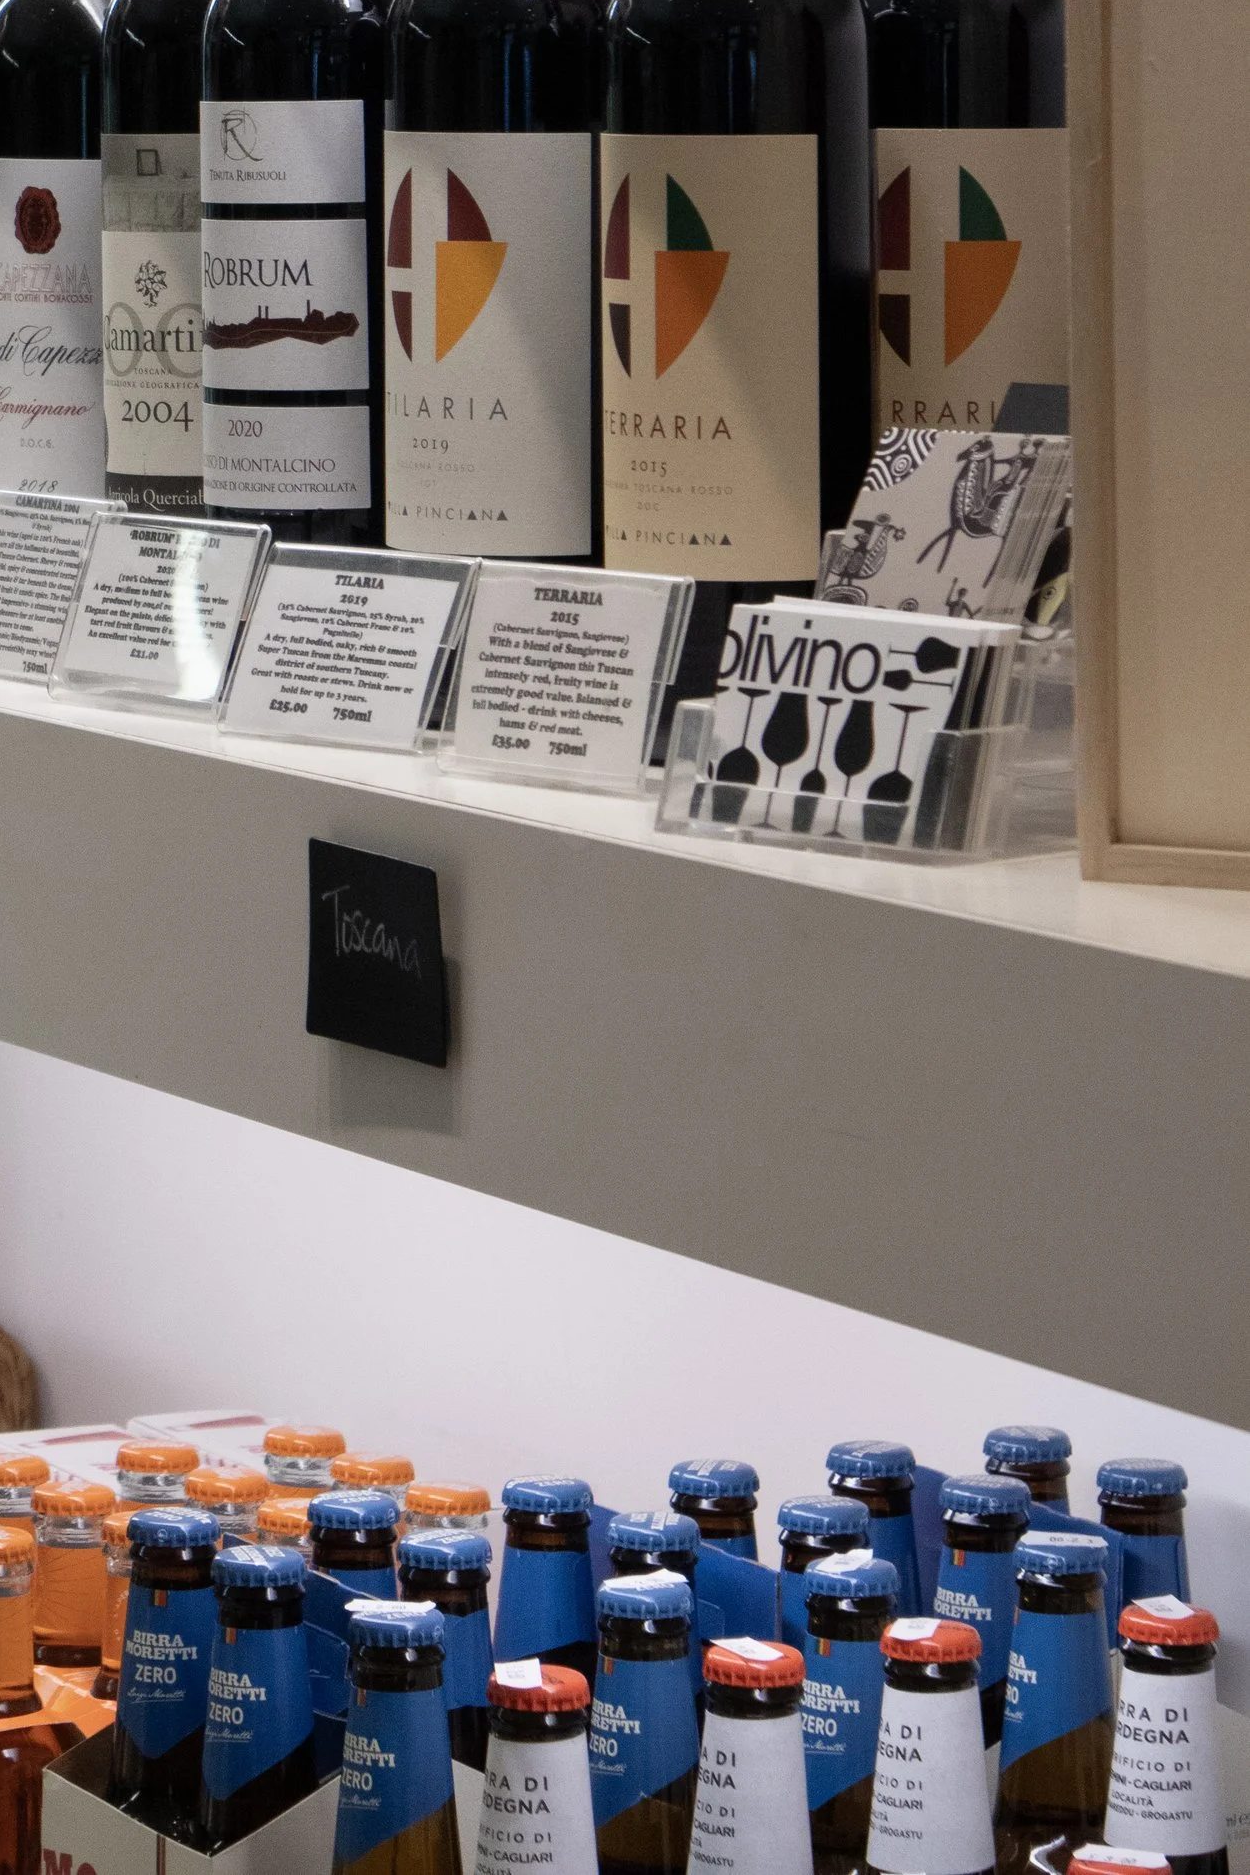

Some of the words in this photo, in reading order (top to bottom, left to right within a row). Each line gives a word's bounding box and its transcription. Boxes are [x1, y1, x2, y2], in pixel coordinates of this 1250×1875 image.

[204, 251, 314, 289] ROBRUM
[121, 400, 194, 433] 2004
[228, 420, 263, 437] 2020
[413, 438, 449, 455] 2019
[230, 458, 336, 473] MONTALCINO
[630, 460, 667, 478] 2015
[277, 482, 358, 493] CONTROLLATA
[335, 575, 385, 590] TILARIA
[534, 587, 603, 606] TERRARIA
[550, 611, 580, 626] 2015
[489, 636, 512, 648] With
[522, 640, 551, 653] blend
[597, 662, 634, 676] Tuscan
[269, 699, 308, 714] £25.00
[333, 707, 372, 723] 750ml
[492, 733, 531, 749] £35.00
[549, 741, 587, 756] 750ml
[321, 885, 423, 979] Toscana
[132, 1630, 184, 1648] BIRRA
[125, 1639, 198, 1661] MORETTI
[135, 1663, 177, 1685] ZERO
[210, 1701, 244, 1725] ZERO
[801, 1712, 837, 1737] ZERO
[901, 1725, 922, 1742] DI
[716, 1750, 736, 1768] DI
[524, 1776, 549, 1792] DI
